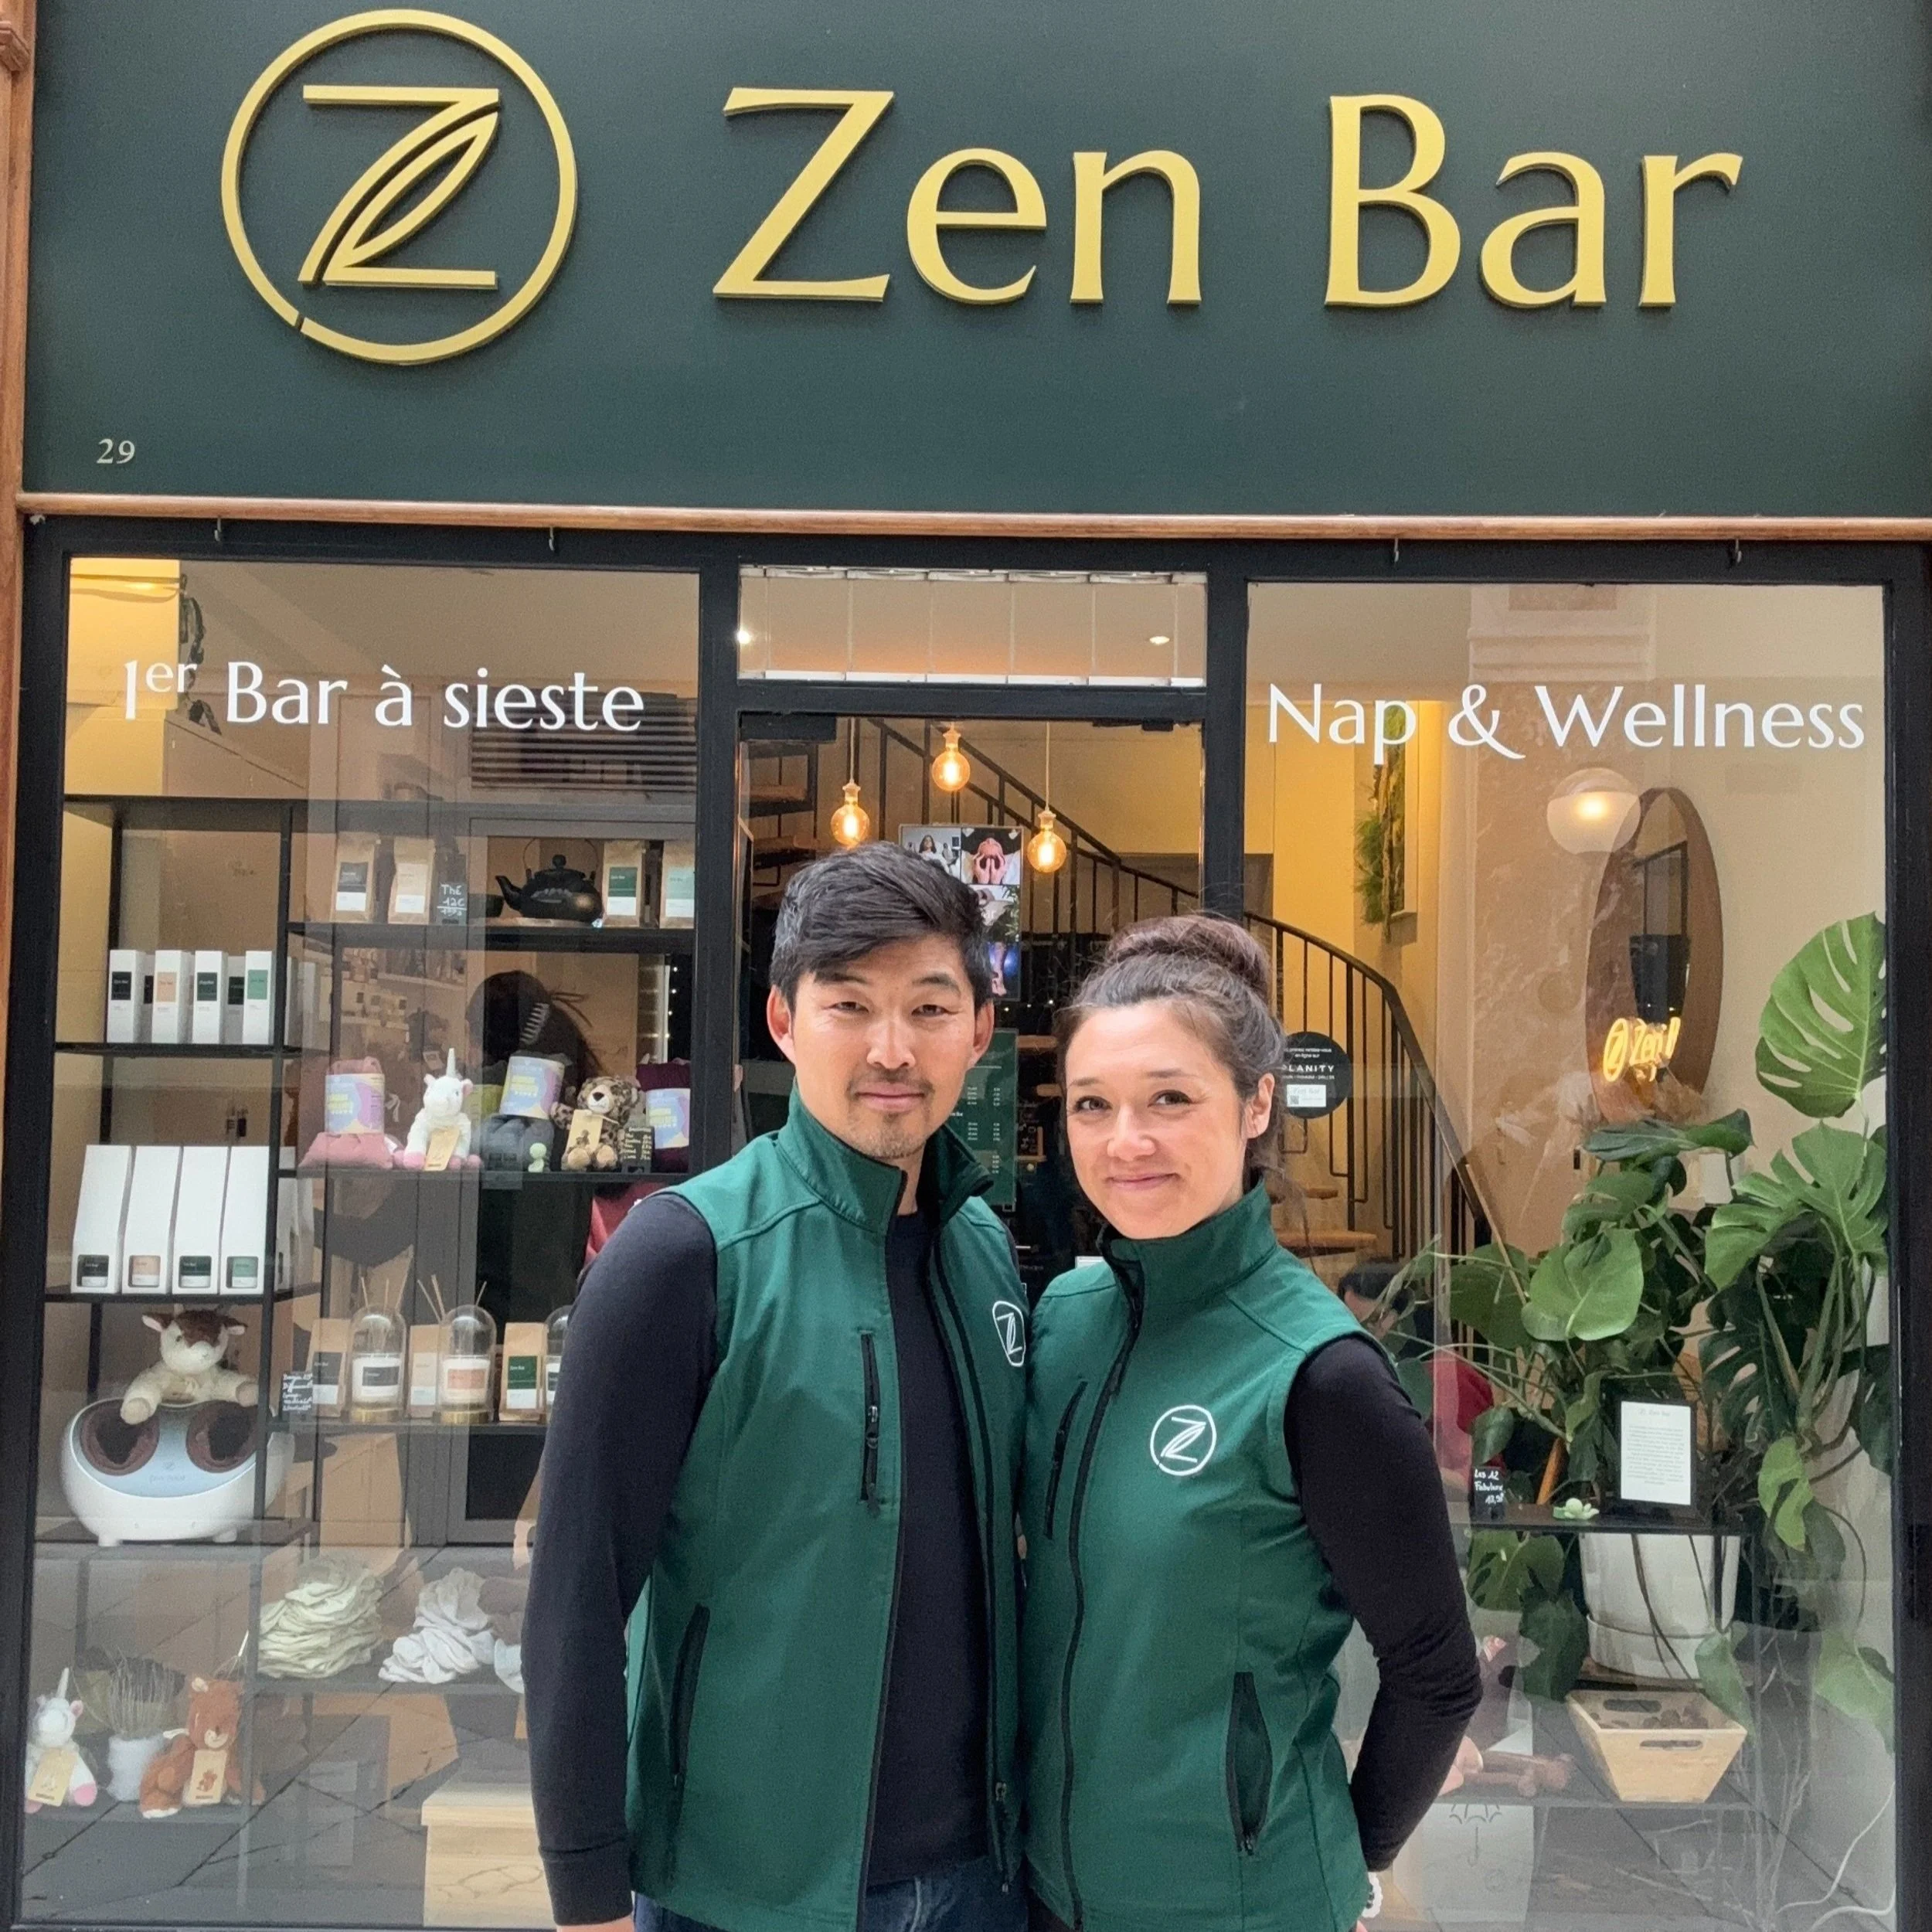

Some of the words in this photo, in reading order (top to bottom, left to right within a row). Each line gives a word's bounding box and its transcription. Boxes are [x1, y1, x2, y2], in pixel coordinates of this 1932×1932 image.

[715, 88, 1202, 303] Zen
[1325, 93, 1744, 310] Bar
[96, 438, 136, 464] 29
[124, 660, 199, 720] 1er
[226, 661, 348, 725] Bar
[375, 664, 413, 726] à
[443, 667, 645, 732] sieste
[1269, 682, 1417, 765] Nap
[1447, 684, 1526, 760] &
[1534, 684, 1866, 749] Wellness
